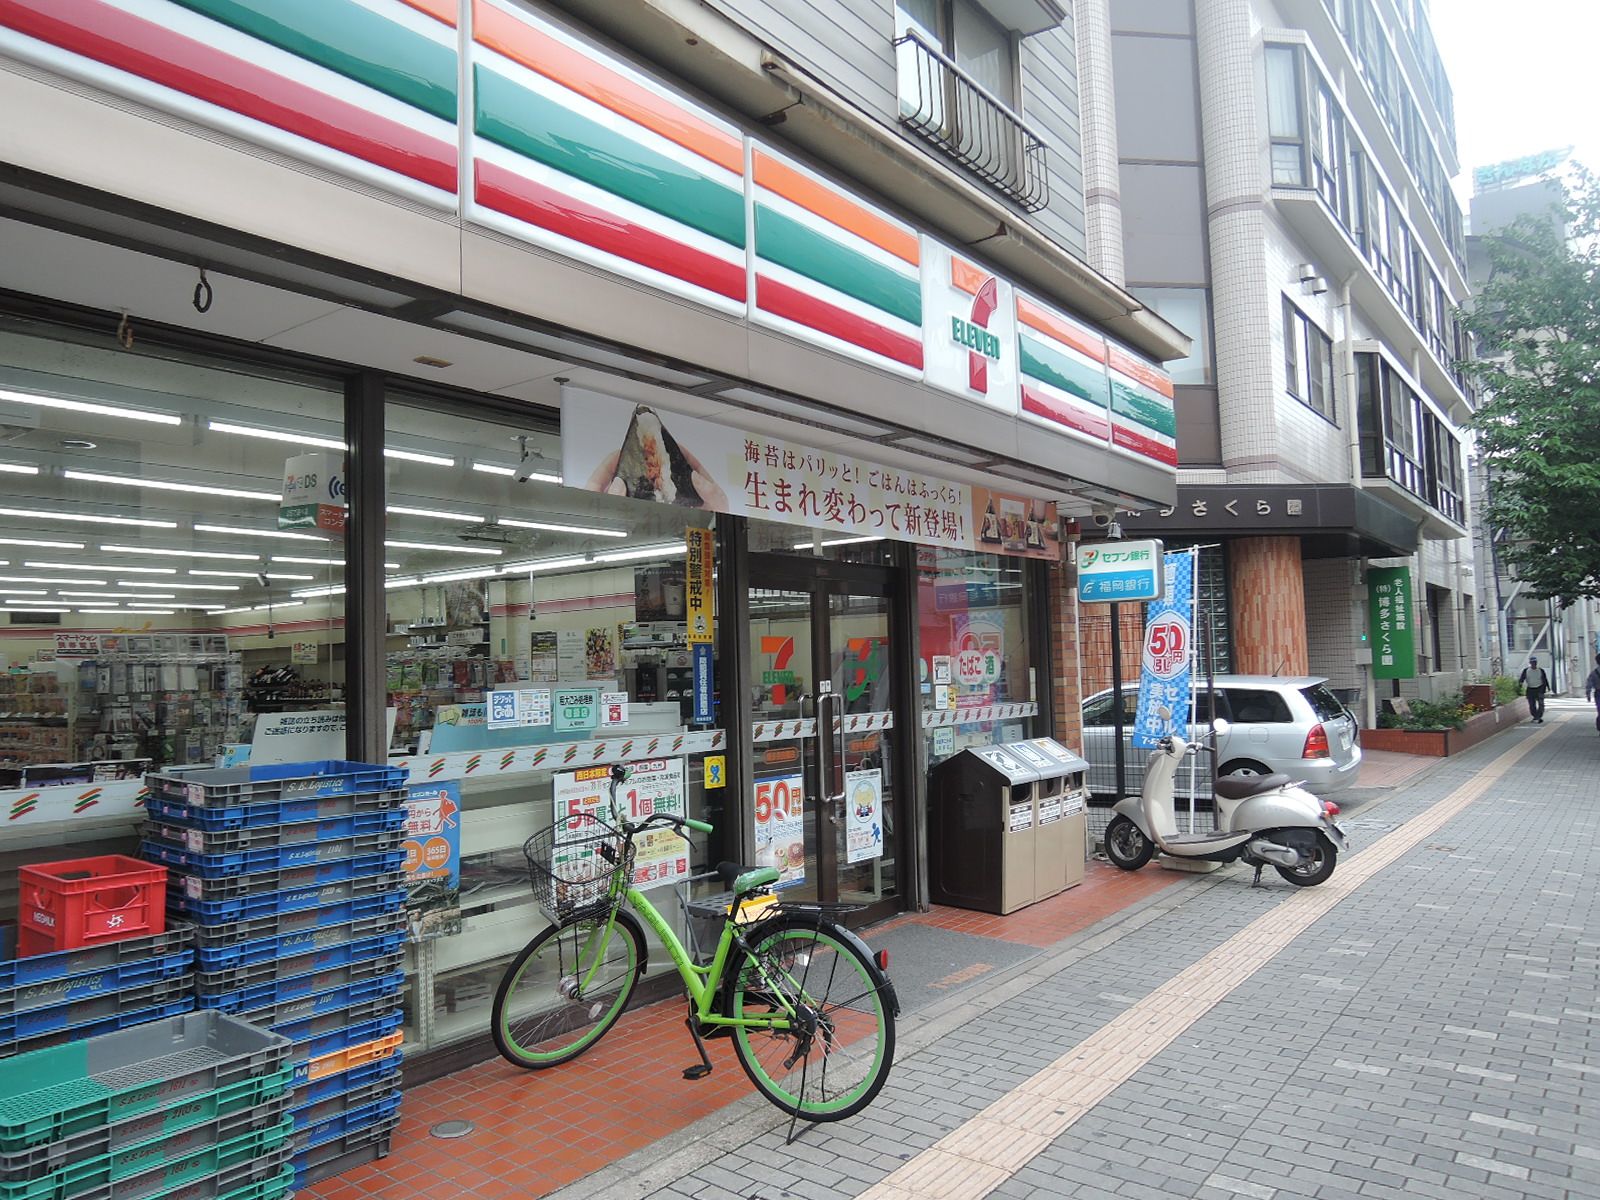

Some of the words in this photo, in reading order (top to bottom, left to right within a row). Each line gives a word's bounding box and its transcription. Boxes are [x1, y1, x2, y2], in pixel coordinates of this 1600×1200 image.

[951, 315, 1001, 361] ELEVEN
[744, 471, 965, 542] 生まれ変わって新登場!
[1101, 549, 1150, 563] セブン銀行
[1098, 576, 1151, 593] 福岡銀行
[1149, 622, 1184, 657] 50
[959, 655, 982, 676] たばこ
[985, 655, 995, 675] 酒
[755, 780, 790, 824] 50
[426, 845, 447, 857] 365日
